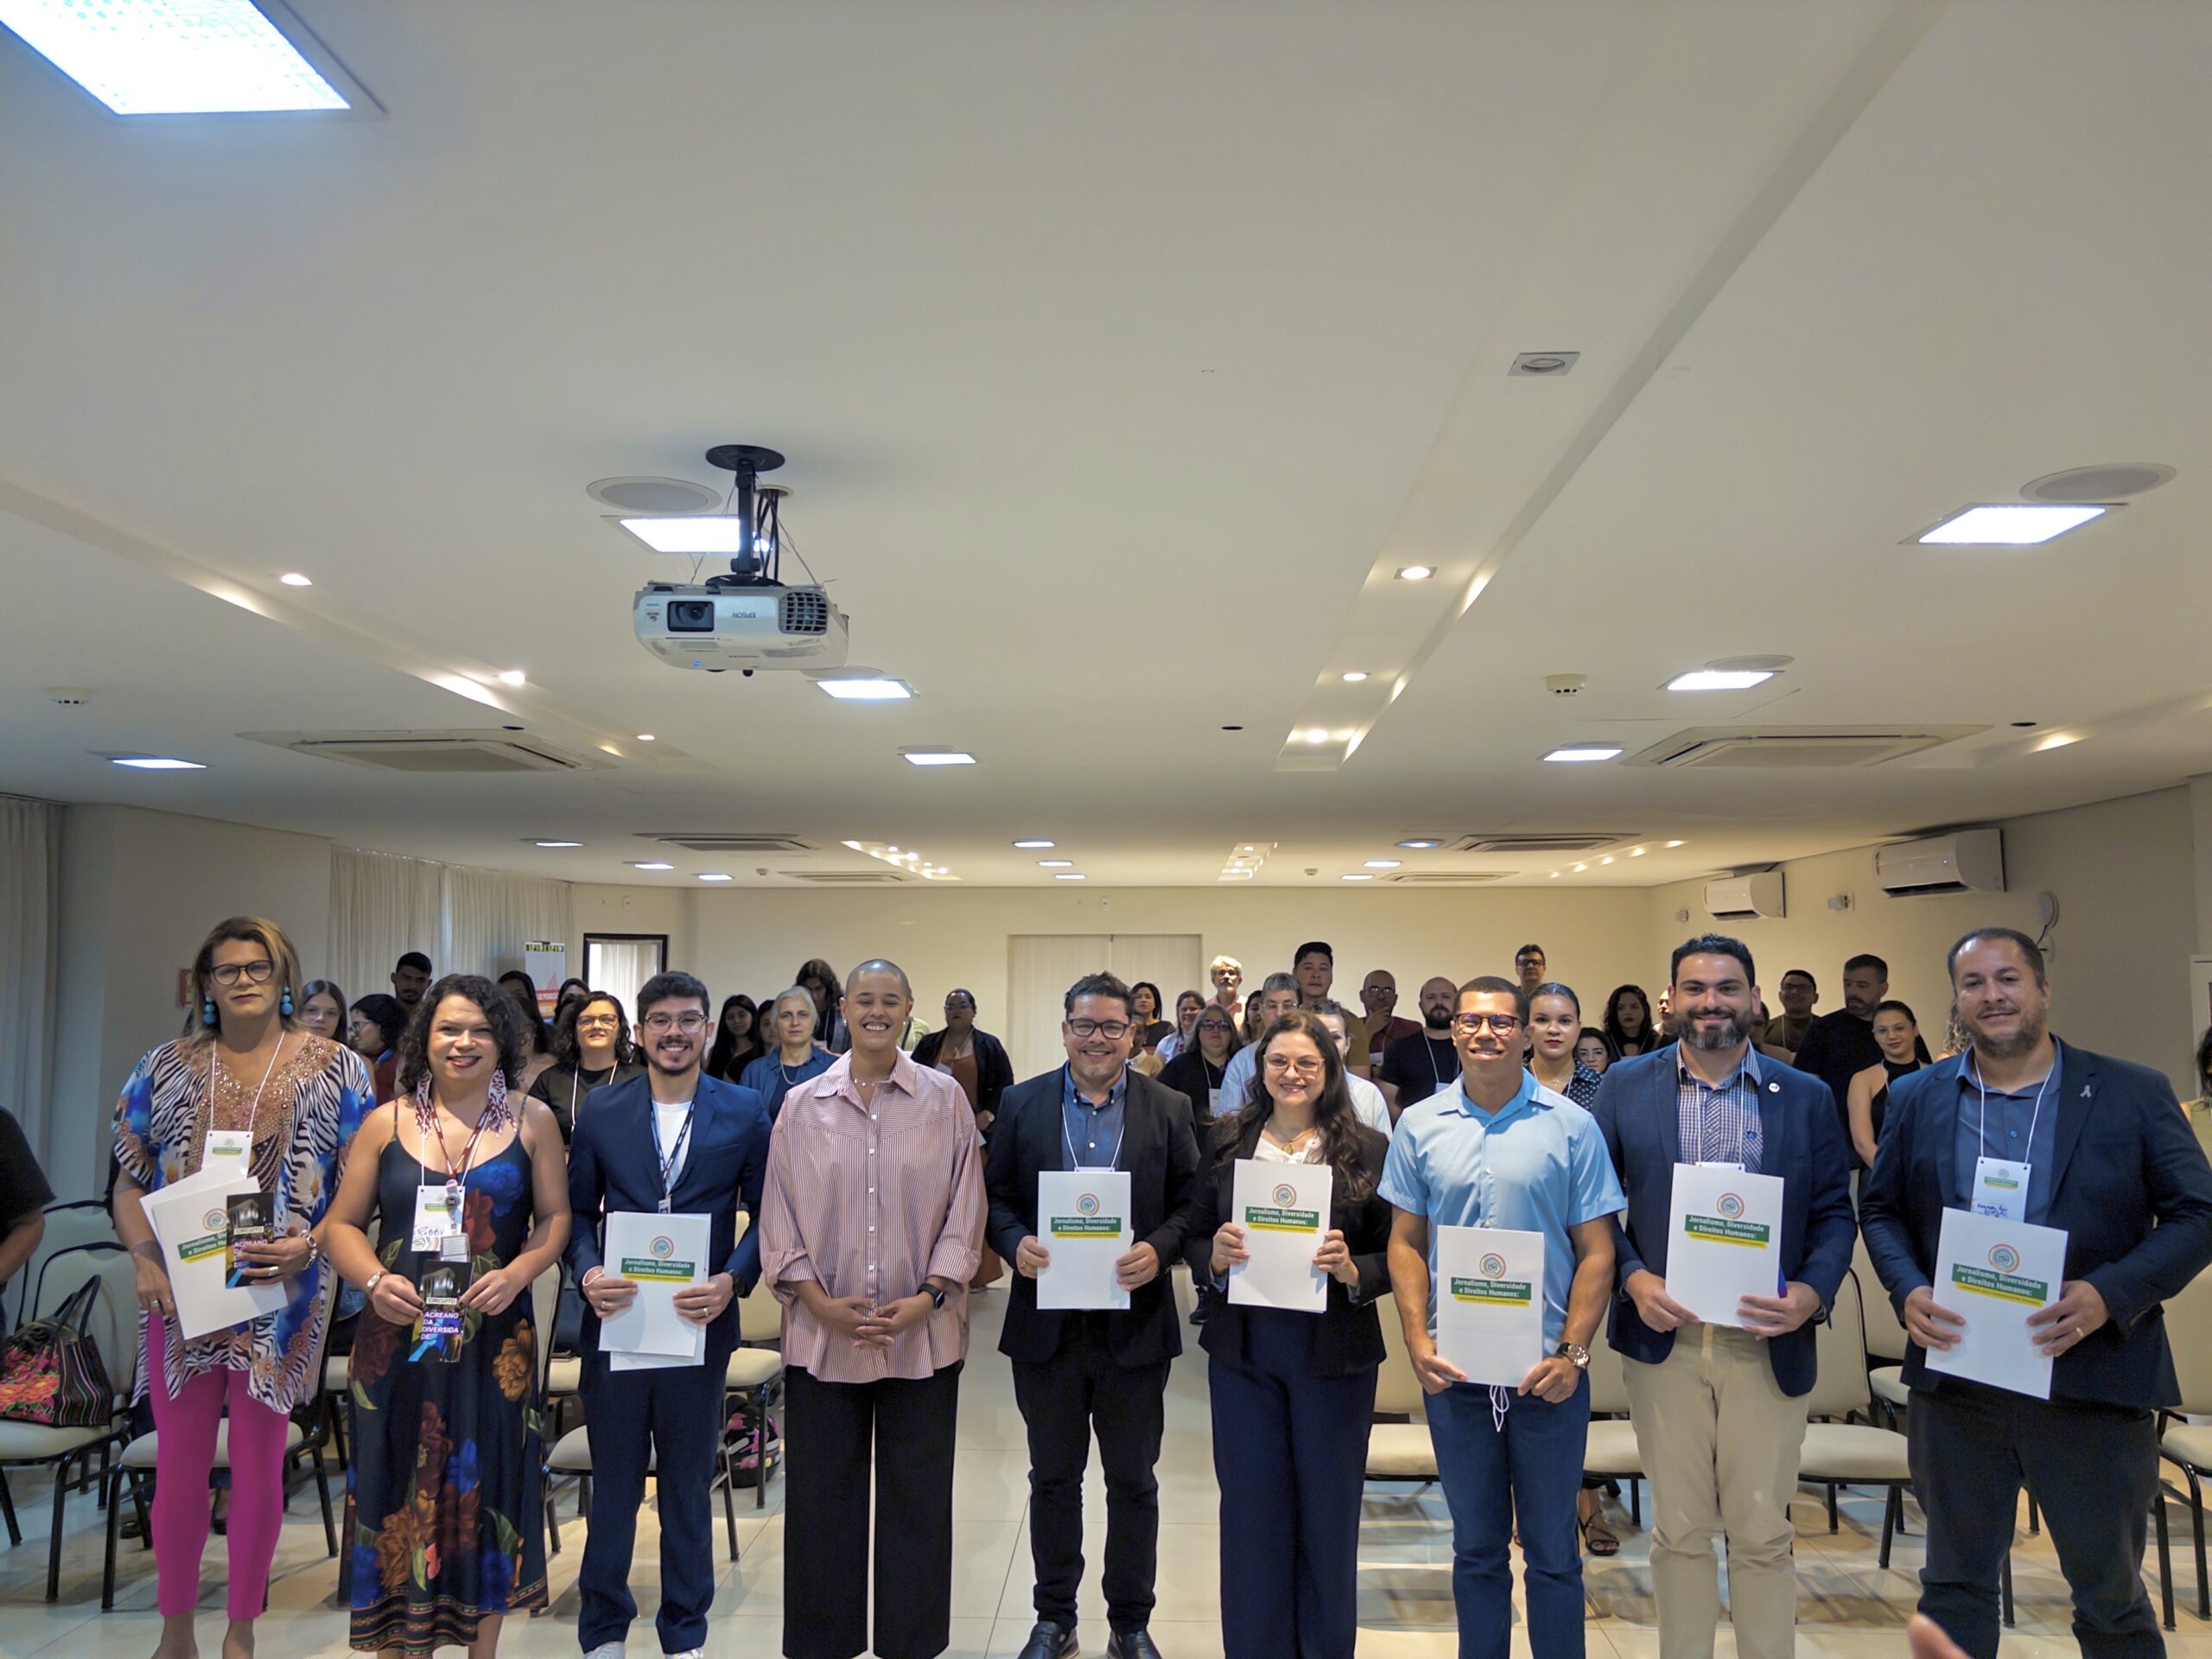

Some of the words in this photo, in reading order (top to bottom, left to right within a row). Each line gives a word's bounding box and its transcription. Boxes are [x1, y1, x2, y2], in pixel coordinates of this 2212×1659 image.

[1281, 1210, 1314, 1218] Diversidade
[1689, 1216, 1726, 1228] Jornalismo,
[1726, 1221, 1764, 1232] Diversidade
[1699, 1224, 1724, 1234] Direitos
[1956, 1266, 1997, 1280] Jornalismo,
[1999, 1274, 2041, 1289] Diversidade
[1454, 1279, 1489, 1288] Jornalismo,
[1490, 1281, 1526, 1290] Diversidade
[1967, 1276, 1995, 1288] Direitos
[1996, 1281, 2032, 1296] Humanos:
[1464, 1287, 1488, 1295] Direitos
